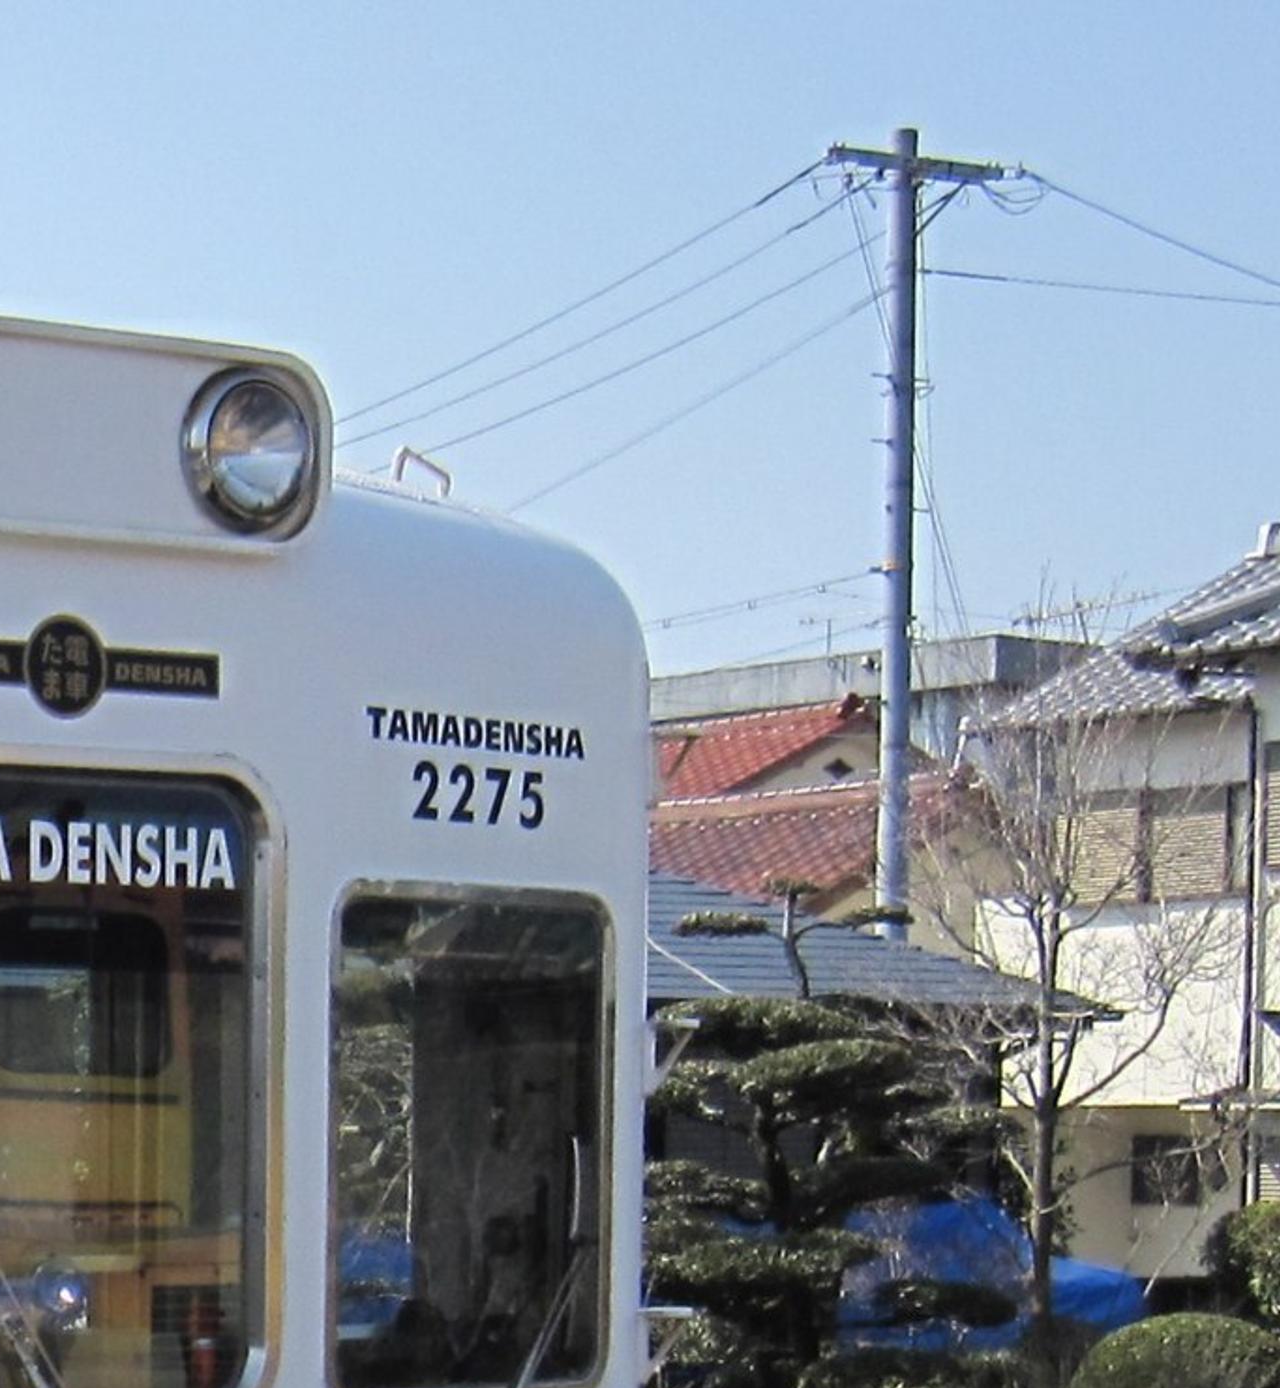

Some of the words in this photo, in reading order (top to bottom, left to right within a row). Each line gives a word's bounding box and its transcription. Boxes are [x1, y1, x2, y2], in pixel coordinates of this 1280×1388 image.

[114, 661, 208, 687] DENSHA
[366, 705, 585, 760] TAMADENSHA
[412, 760, 545, 830] 2275
[28, 819, 236, 890] DENSHA
